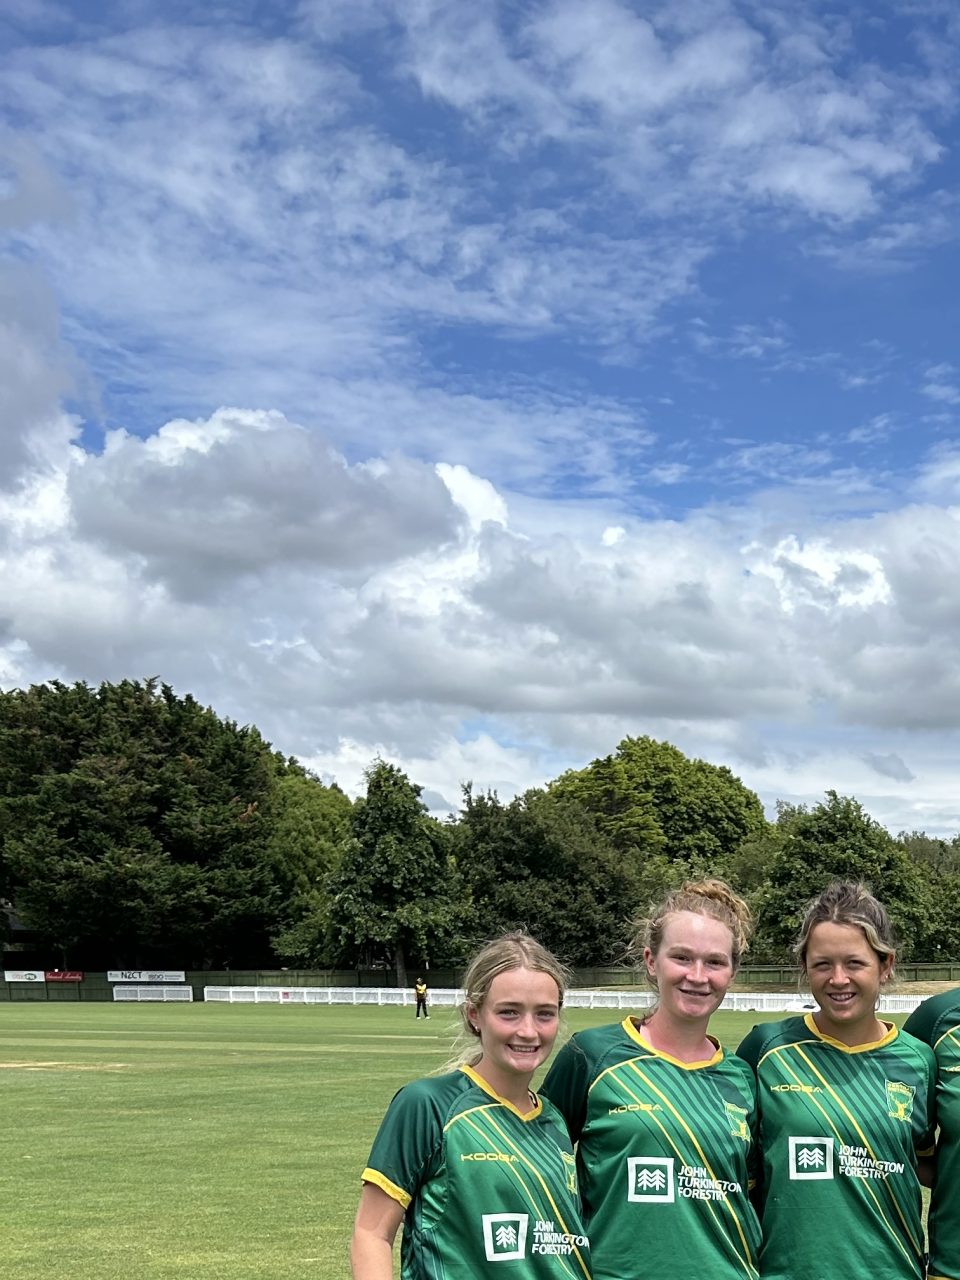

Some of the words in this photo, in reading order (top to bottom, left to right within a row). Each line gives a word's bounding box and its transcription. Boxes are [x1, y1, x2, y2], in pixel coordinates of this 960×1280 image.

[770, 1084, 824, 1094] KOOGA
[608, 1103, 664, 1115] KOOGA
[838, 1145, 868, 1157] JOHN
[460, 1152, 520, 1163] KOOGA
[838, 1155, 905, 1174] TURKINGTON
[677, 1165, 707, 1178] JOHN
[838, 1166, 889, 1180] FORESTRY
[677, 1176, 743, 1193] TURKINGTON
